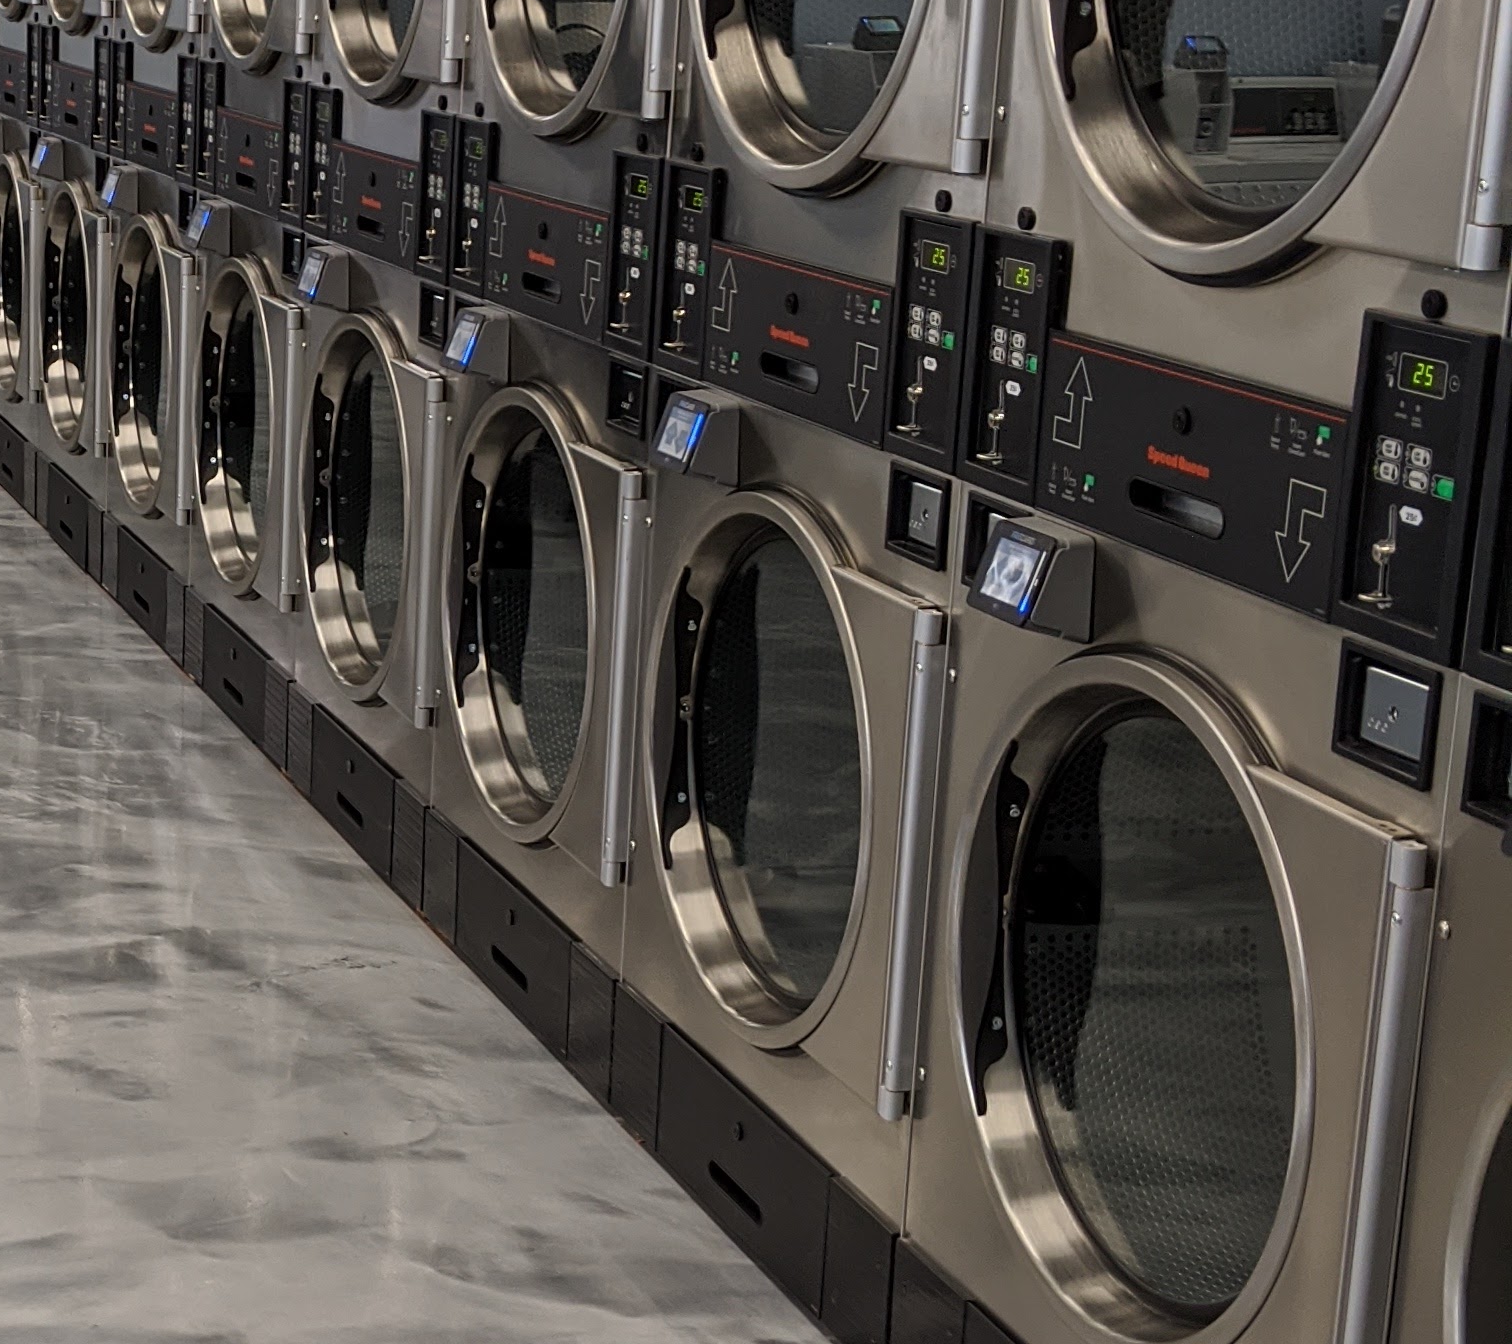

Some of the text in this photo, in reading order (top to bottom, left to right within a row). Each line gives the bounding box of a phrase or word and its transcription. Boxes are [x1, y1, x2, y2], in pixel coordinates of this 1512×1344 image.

[932, 247, 946, 266] 25
[1015, 267, 1030, 286] 25
[1412, 362, 1435, 387] 25
